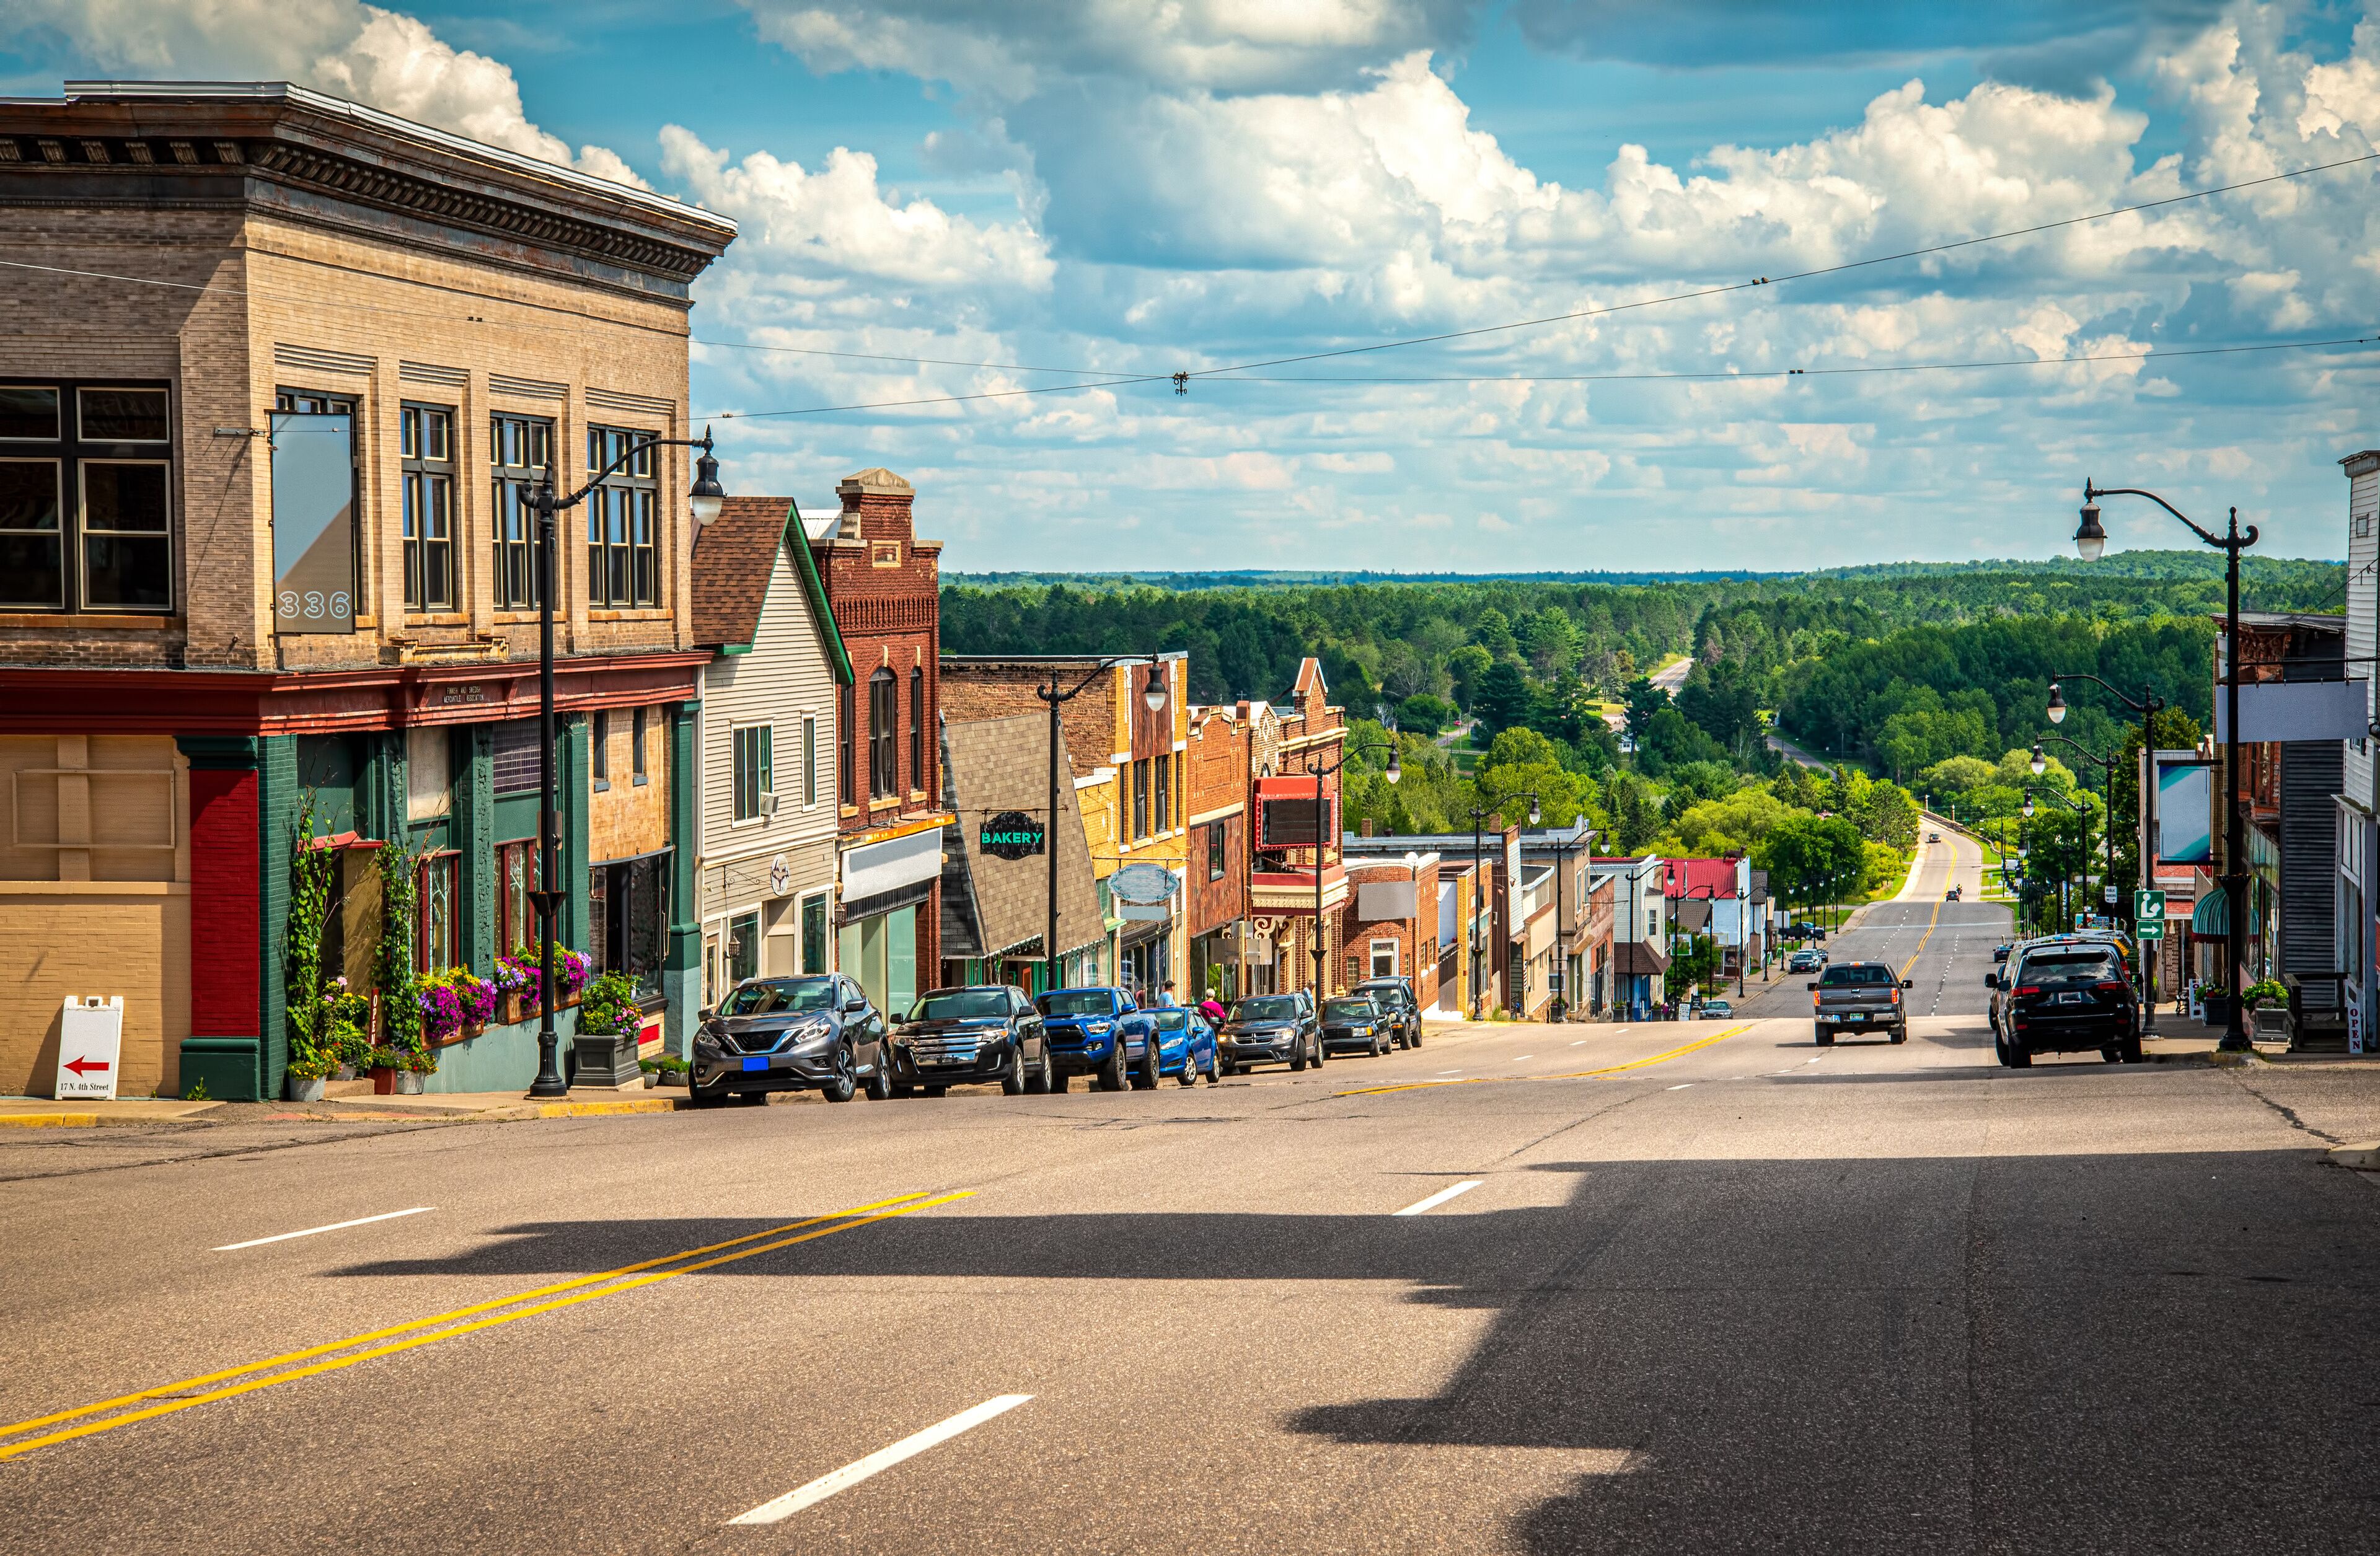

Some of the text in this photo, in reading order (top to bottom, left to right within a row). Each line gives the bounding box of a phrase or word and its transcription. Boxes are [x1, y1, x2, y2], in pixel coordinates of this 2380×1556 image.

[278, 591, 350, 618] 336
[443, 695, 461, 703] MERCANTILE
[981, 832, 1042, 843] BAKERY
[2350, 1008, 2360, 1049] OPEN
[60, 1083, 108, 1091] 17 N. 4th Street
